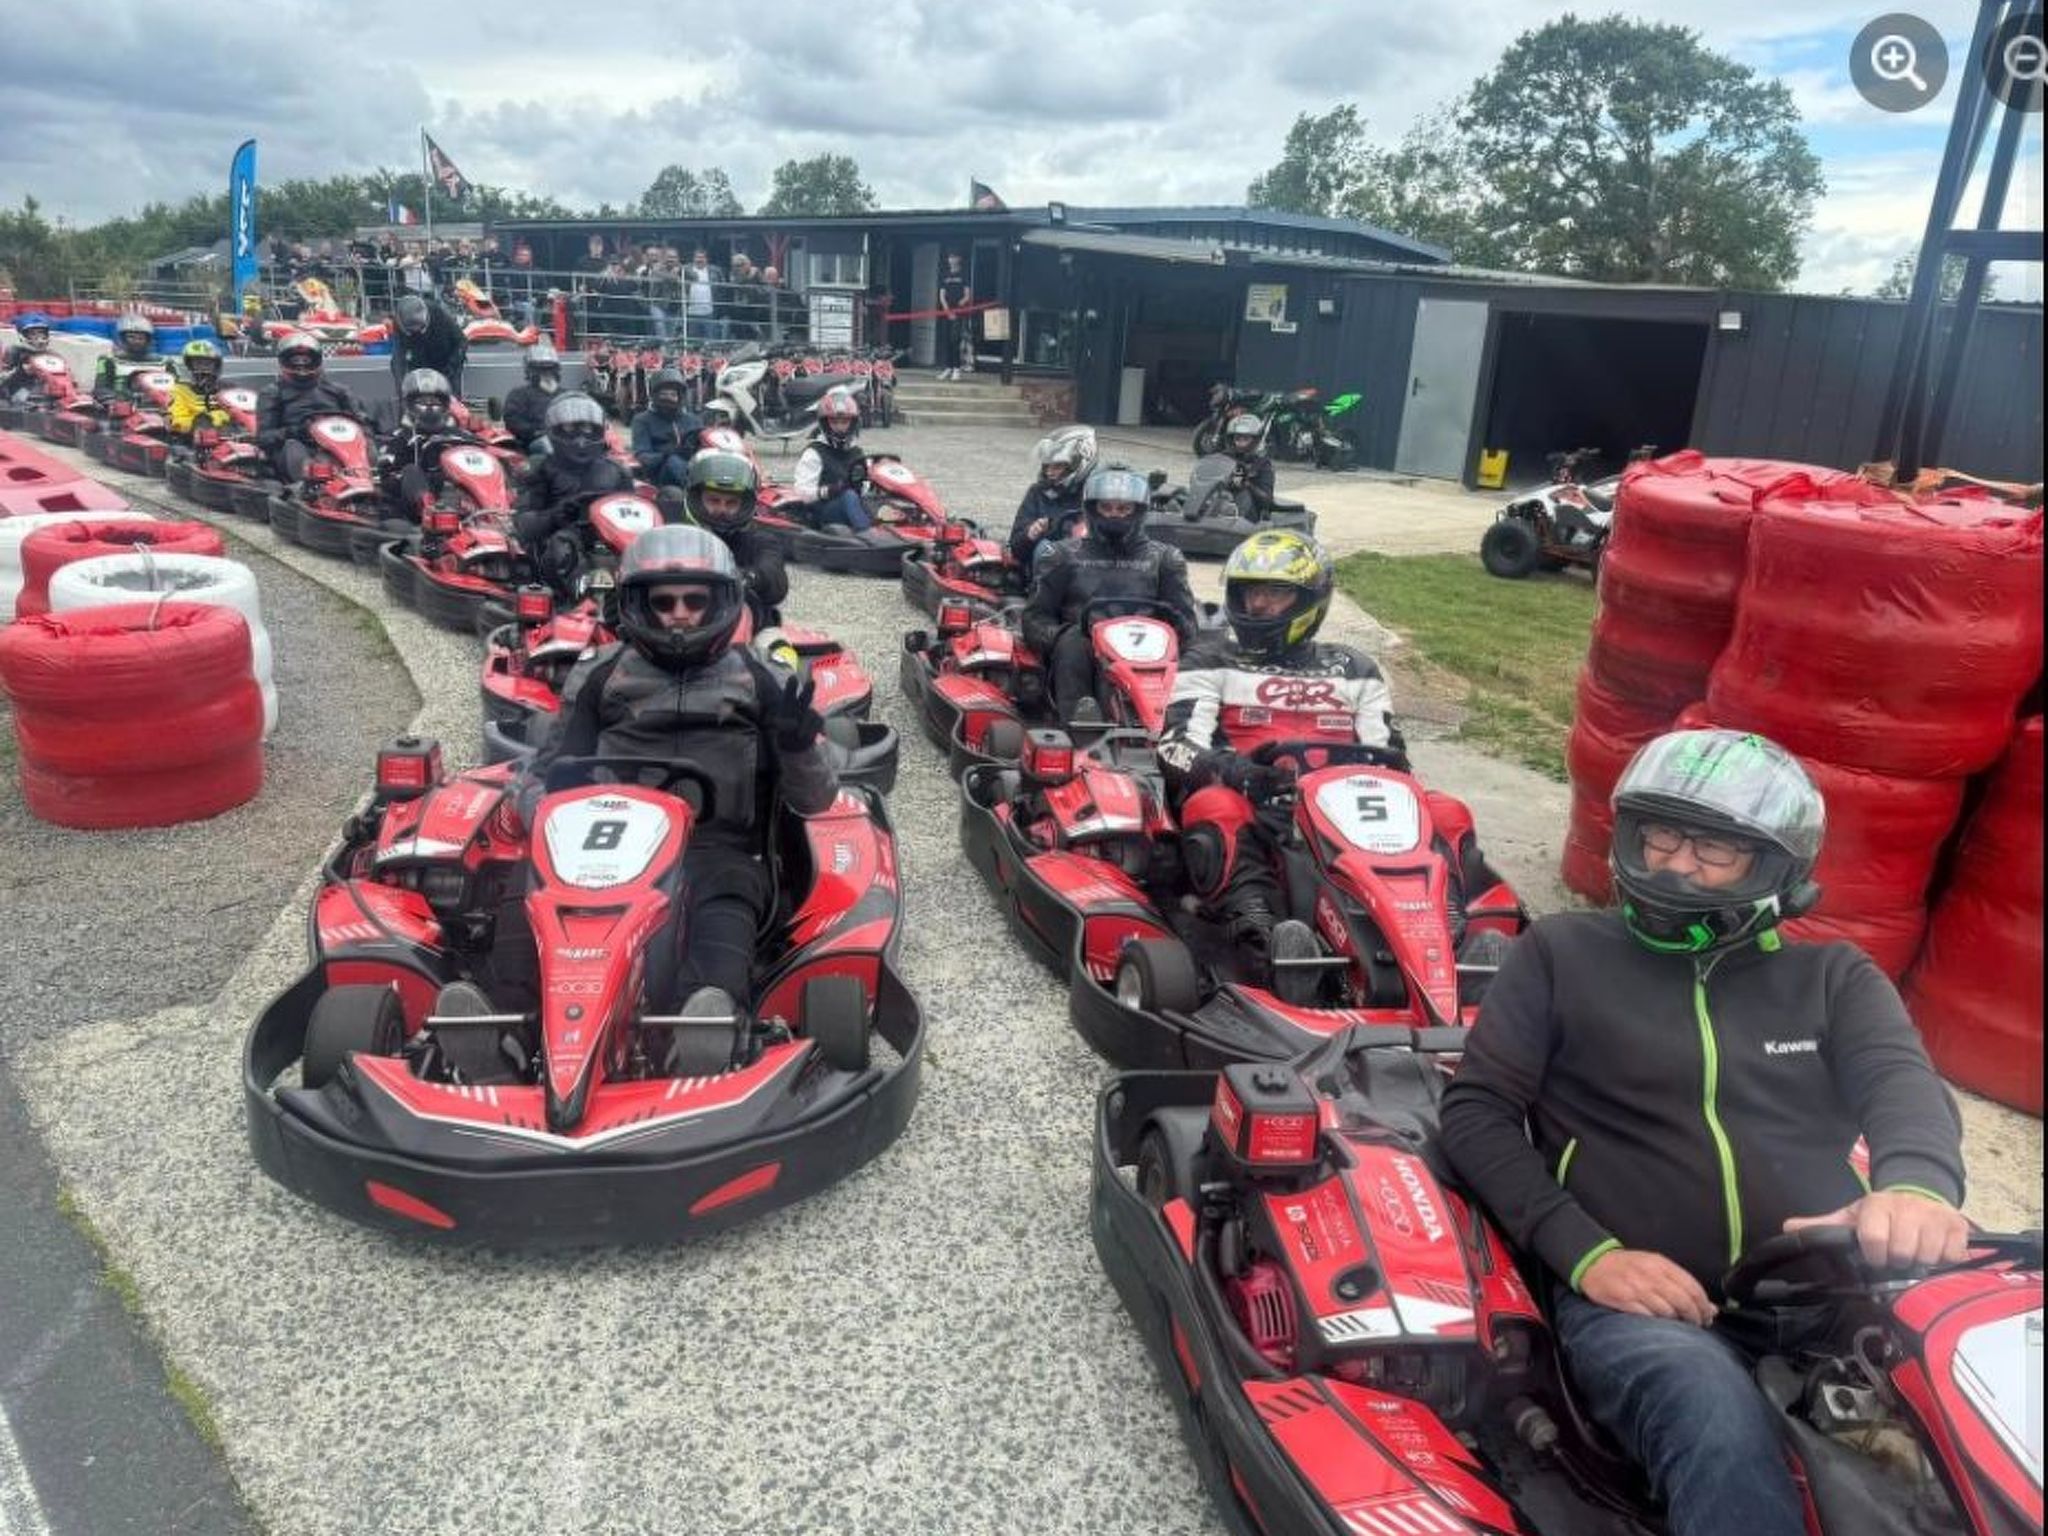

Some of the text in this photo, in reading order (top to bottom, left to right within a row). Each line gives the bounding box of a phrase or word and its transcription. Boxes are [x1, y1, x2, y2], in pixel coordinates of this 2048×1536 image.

[1129, 632, 1147, 646] 7
[1357, 795, 1388, 822] 5
[582, 820, 629, 851] 8
[1391, 1157, 1444, 1243] HONDA
